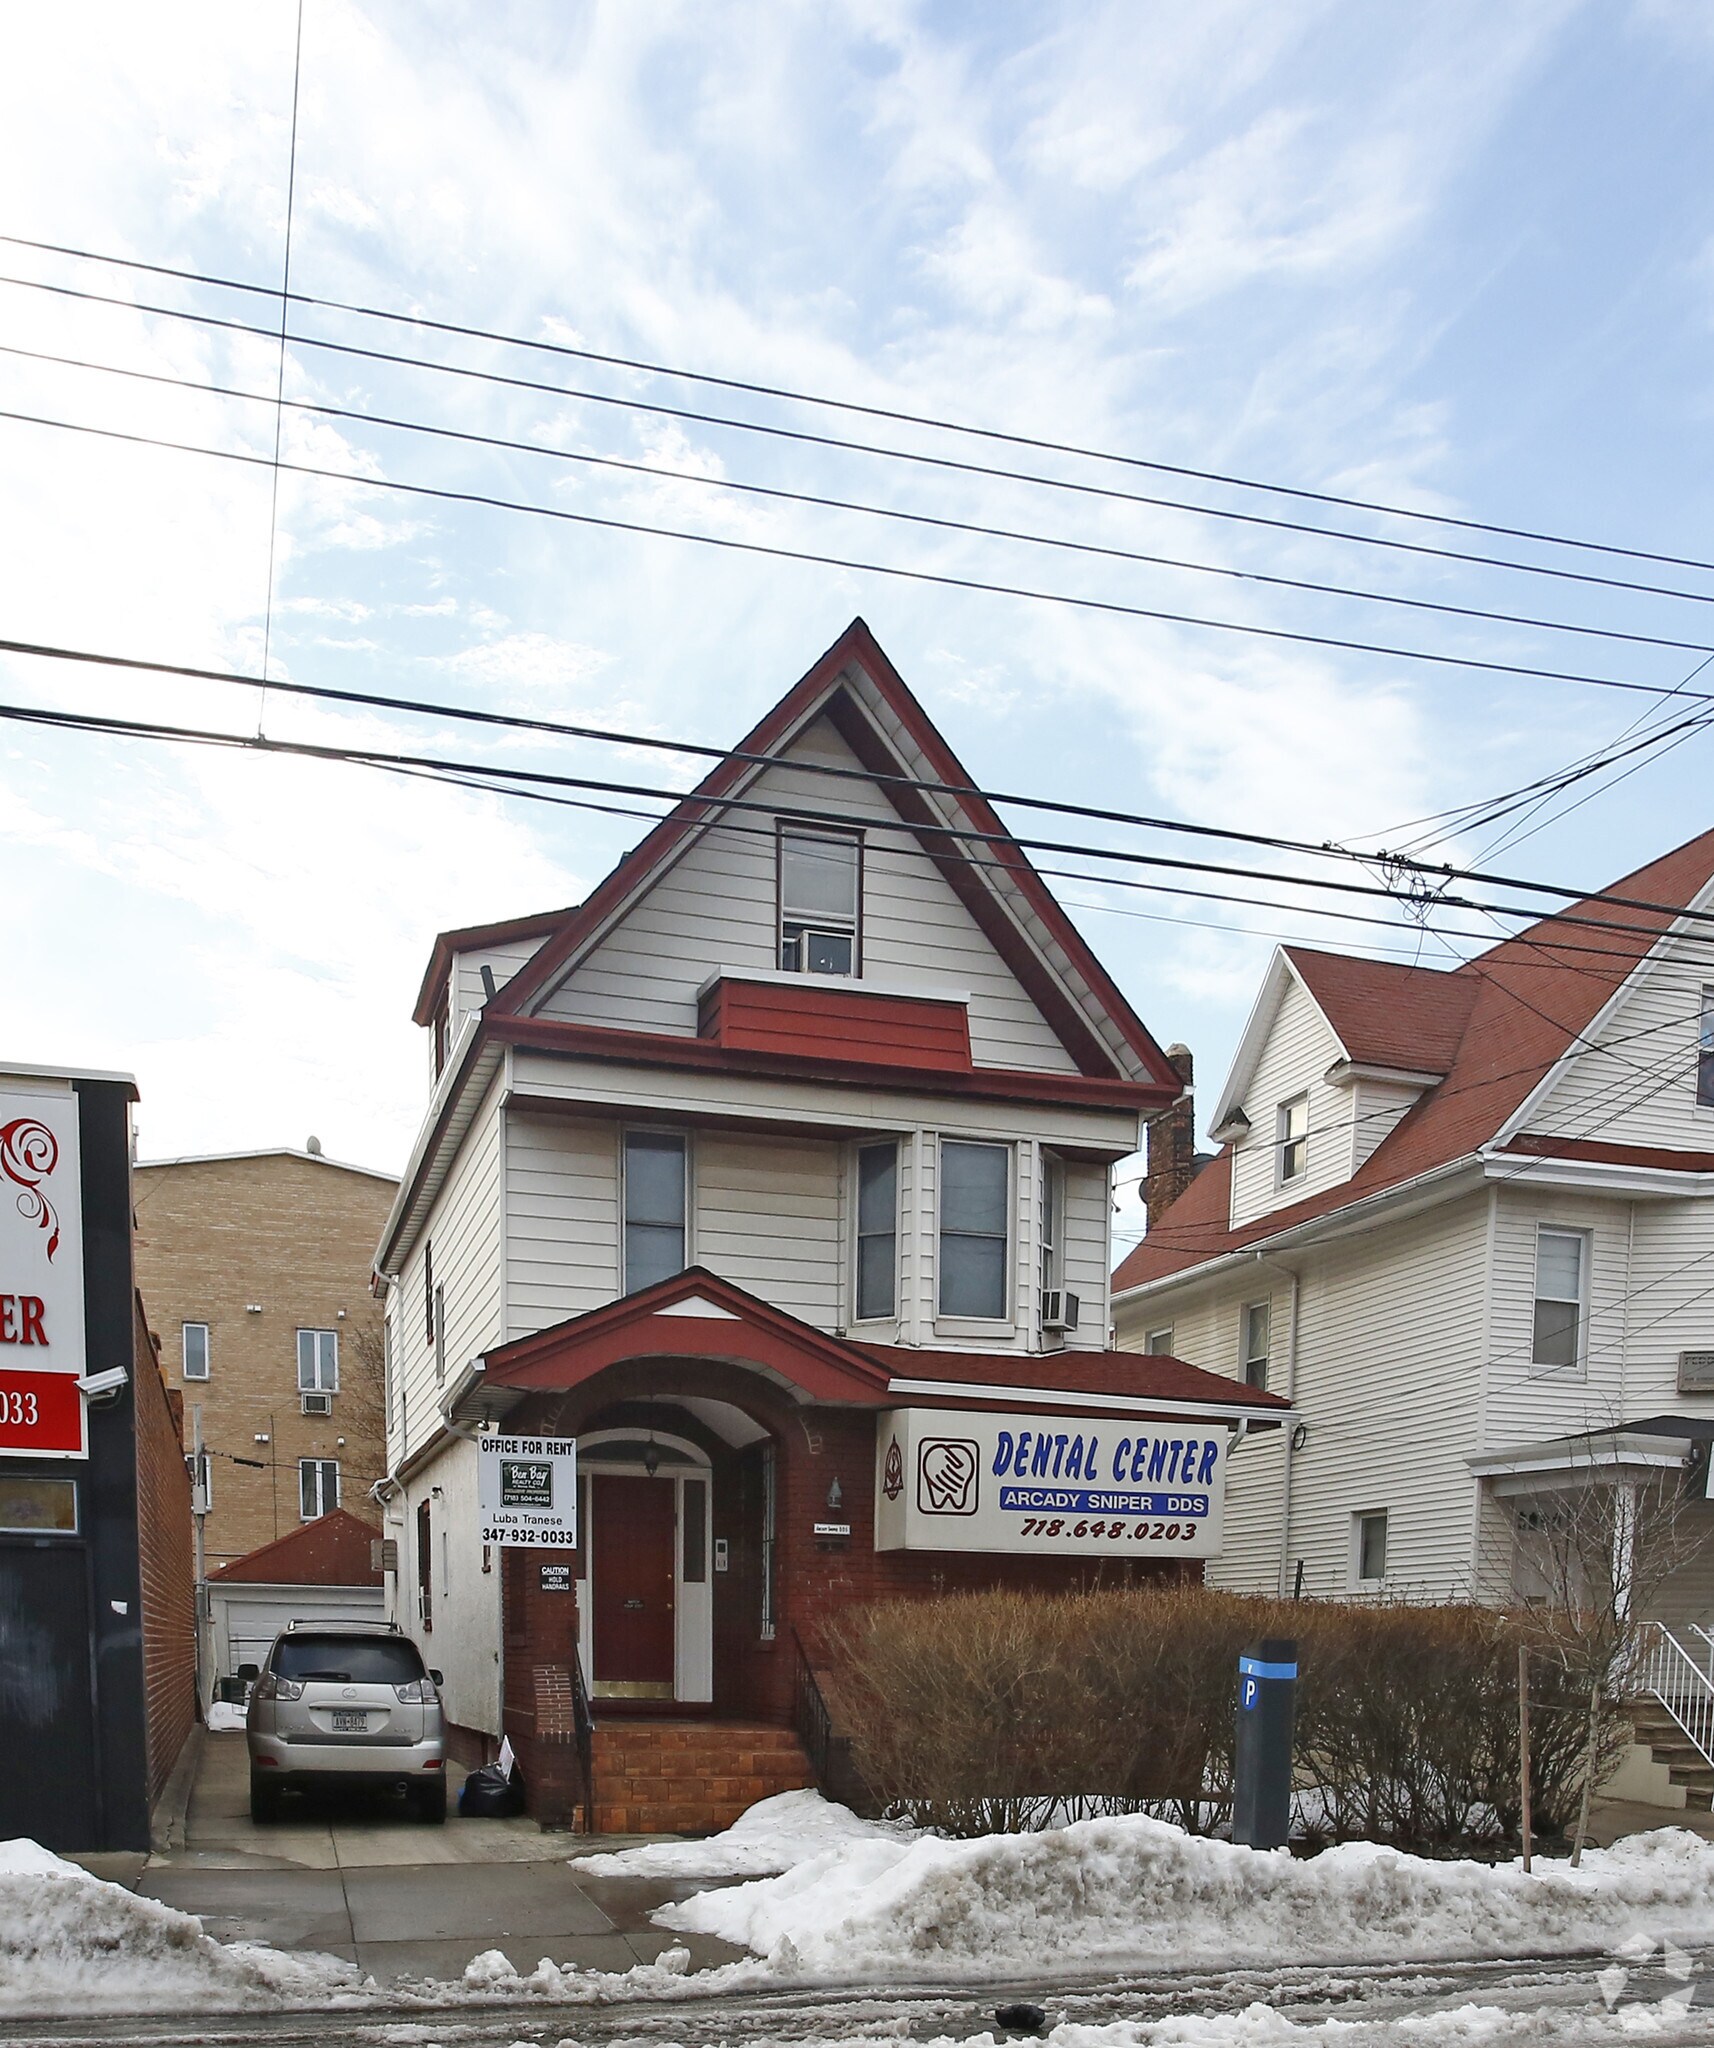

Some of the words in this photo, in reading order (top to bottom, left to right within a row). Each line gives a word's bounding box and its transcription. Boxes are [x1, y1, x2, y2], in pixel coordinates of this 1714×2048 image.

[482, 1439, 518, 1453] OFFICE
[522, 1441, 542, 1454] FOR
[547, 1442, 572, 1456] RENT
[992, 1431, 1099, 1481] DENTAL
[1112, 1438, 1219, 1486] CENTER
[529, 1466, 548, 1487] Bay
[1004, 1491, 1080, 1508] ARCADY
[1087, 1494, 1153, 1511] SNIPER
[1167, 1497, 1205, 1512] DDS
[493, 1513, 518, 1523] Luba
[522, 1514, 562, 1525] Tranese
[1020, 1518, 1197, 1541] 718.648.0203
[482, 1528, 573, 1543] 347-932-0033
[541, 1566, 569, 1575] CAUTION
[1245, 1680, 1256, 1706] P
